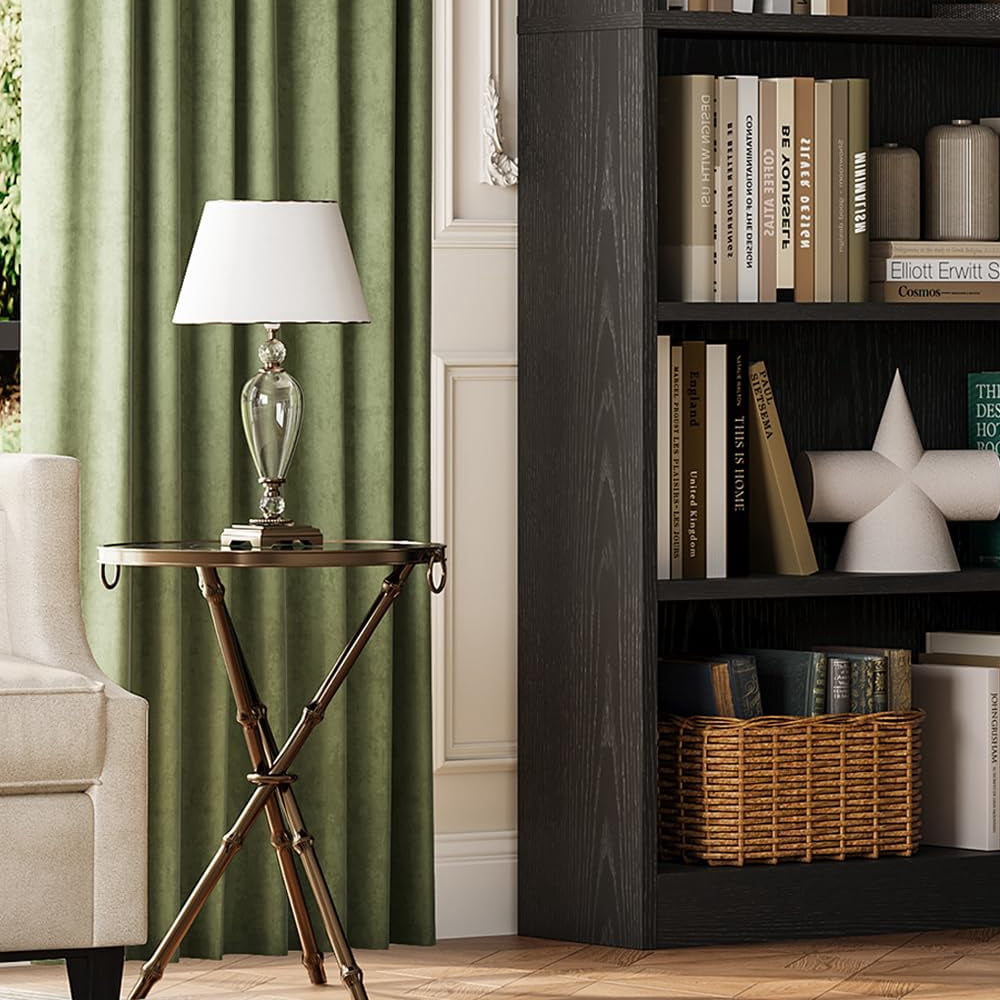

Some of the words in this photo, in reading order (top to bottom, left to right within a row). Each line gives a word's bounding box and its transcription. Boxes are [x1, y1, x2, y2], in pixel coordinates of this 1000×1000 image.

[890, 261, 933, 280] Elliott
[938, 261, 983, 280] Erwitt
[898, 285, 942, 298] Cosmos
[688, 371, 701, 427] England
[759, 370, 774, 406] PAUL
[751, 372, 774, 441] SIETSEMA
[734, 415, 745, 449] THIS
[734, 452, 745, 465] IS
[690, 470, 698, 507] United
[734, 468, 745, 512] HOME
[688, 510, 698, 558] Kingdom
